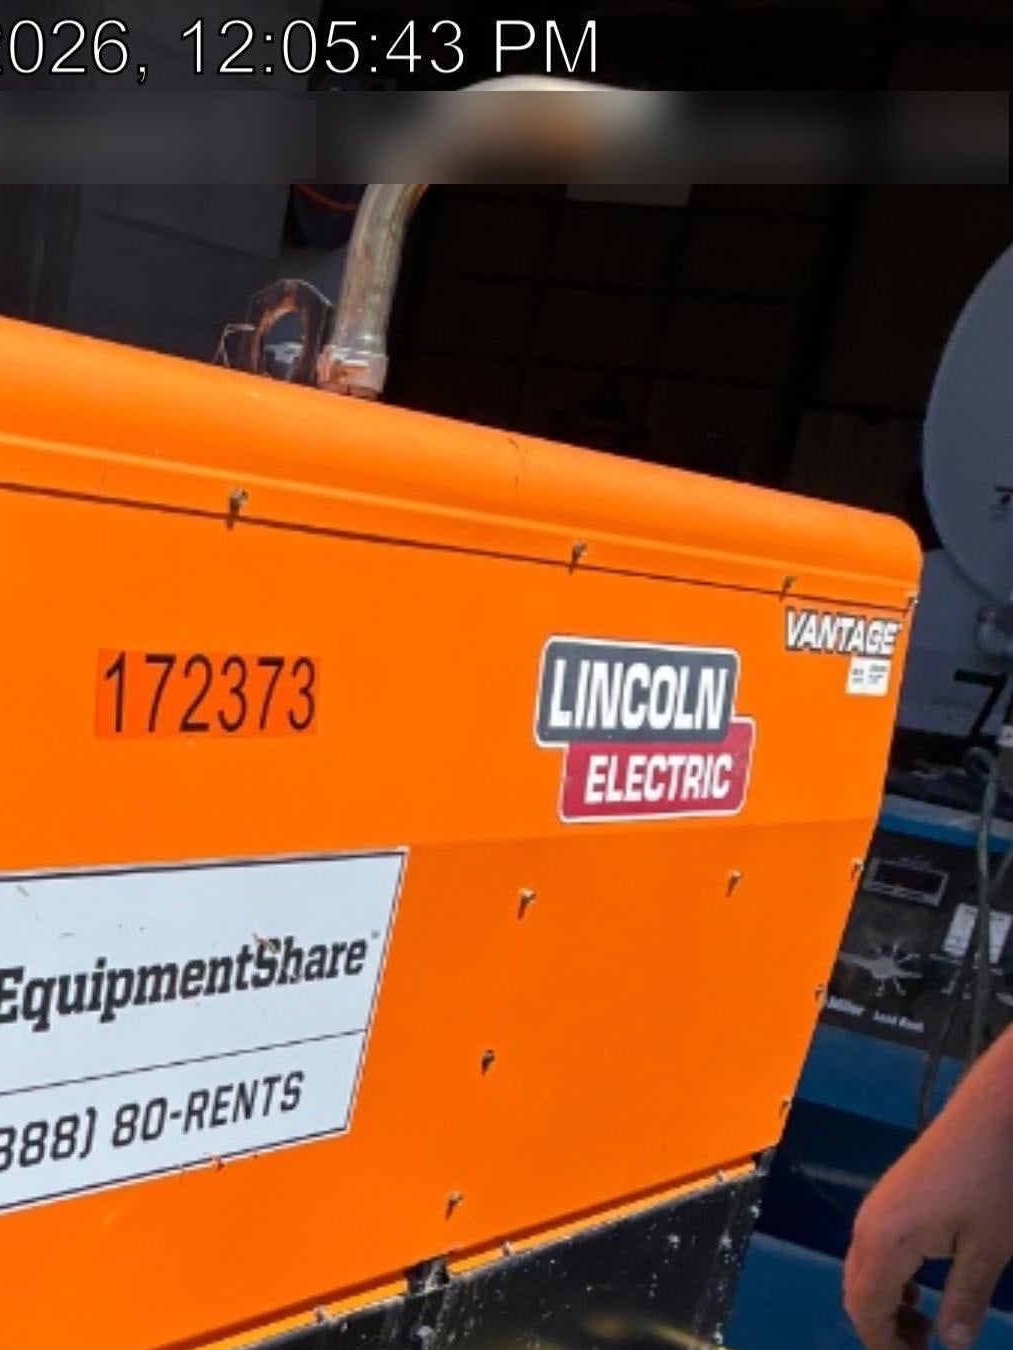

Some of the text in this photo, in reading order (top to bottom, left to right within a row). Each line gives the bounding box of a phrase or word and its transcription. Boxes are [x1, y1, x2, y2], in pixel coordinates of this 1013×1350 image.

[786, 607, 900, 658] VANTAGE
[104, 651, 316, 733] 172373
[549, 659, 729, 730] LINCOLN
[584, 754, 733, 805] ELECTRIC
[112, 1070, 305, 1147] 80-RENTS
